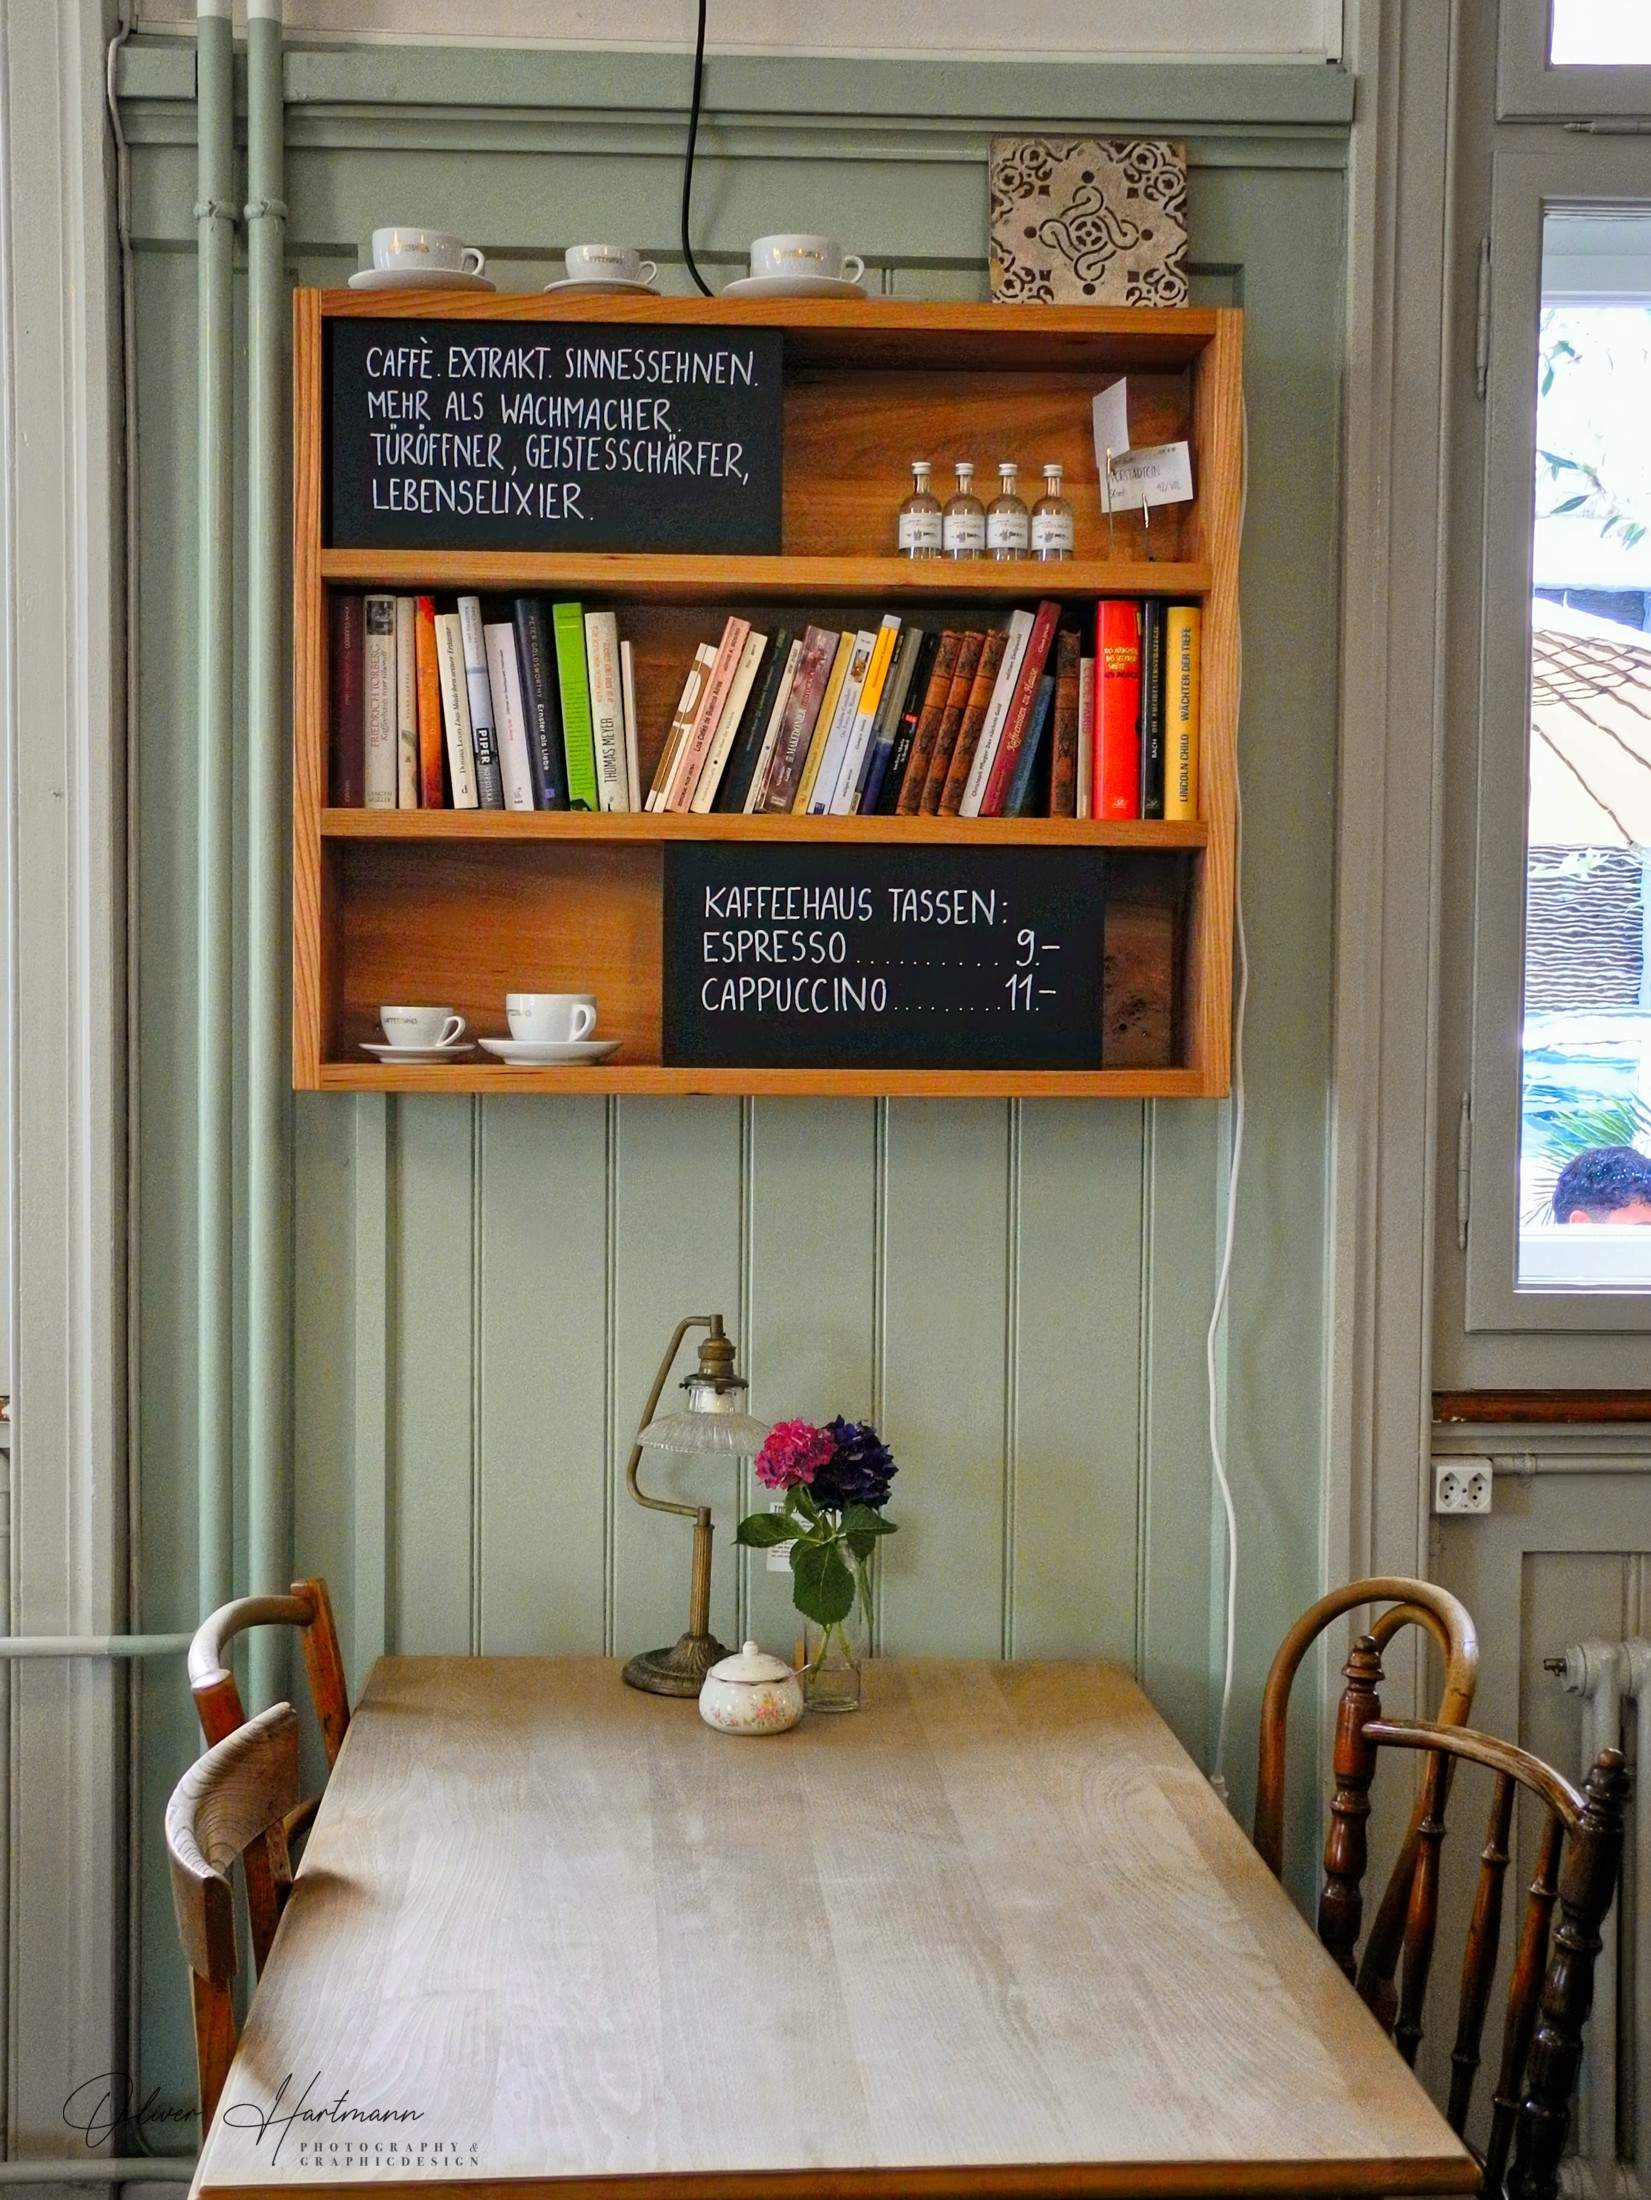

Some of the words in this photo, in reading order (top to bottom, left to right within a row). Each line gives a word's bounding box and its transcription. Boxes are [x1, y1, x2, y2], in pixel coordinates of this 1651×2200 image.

[366, 336, 441, 380] CAFFÈ.
[448, 346, 552, 380] EXTRAKT.
[565, 346, 759, 387] SINNESSEHNEN.
[367, 390, 431, 421] MEHR
[445, 390, 484, 422] ALS
[500, 392, 682, 434] WACHMACHER.
[525, 433, 749, 486] GEISTESSCHÄRFER,
[372, 478, 595, 521] LEBENSELIXIER.
[1183, 627, 1191, 652] TIEFE
[1182, 653, 1191, 671] DER
[1181, 673, 1191, 721] WÄCHTER
[535, 703, 547, 732] Ernster
[599, 717, 614, 746] MEYER
[477, 729, 491, 764] PIPER
[539, 733, 548, 747] als
[1181, 734, 1189, 760] CHILD
[540, 748, 550, 771] Liebe
[603, 747, 617, 783] THOMAS
[1180, 762, 1189, 802] LINCOLN
[705, 885, 873, 922] KAFFEEHAUS
[888, 888, 1008, 926] TASSEN:
[703, 929, 846, 964] ESPRESSO
[701, 976, 887, 1014] CAPPUCCINO
